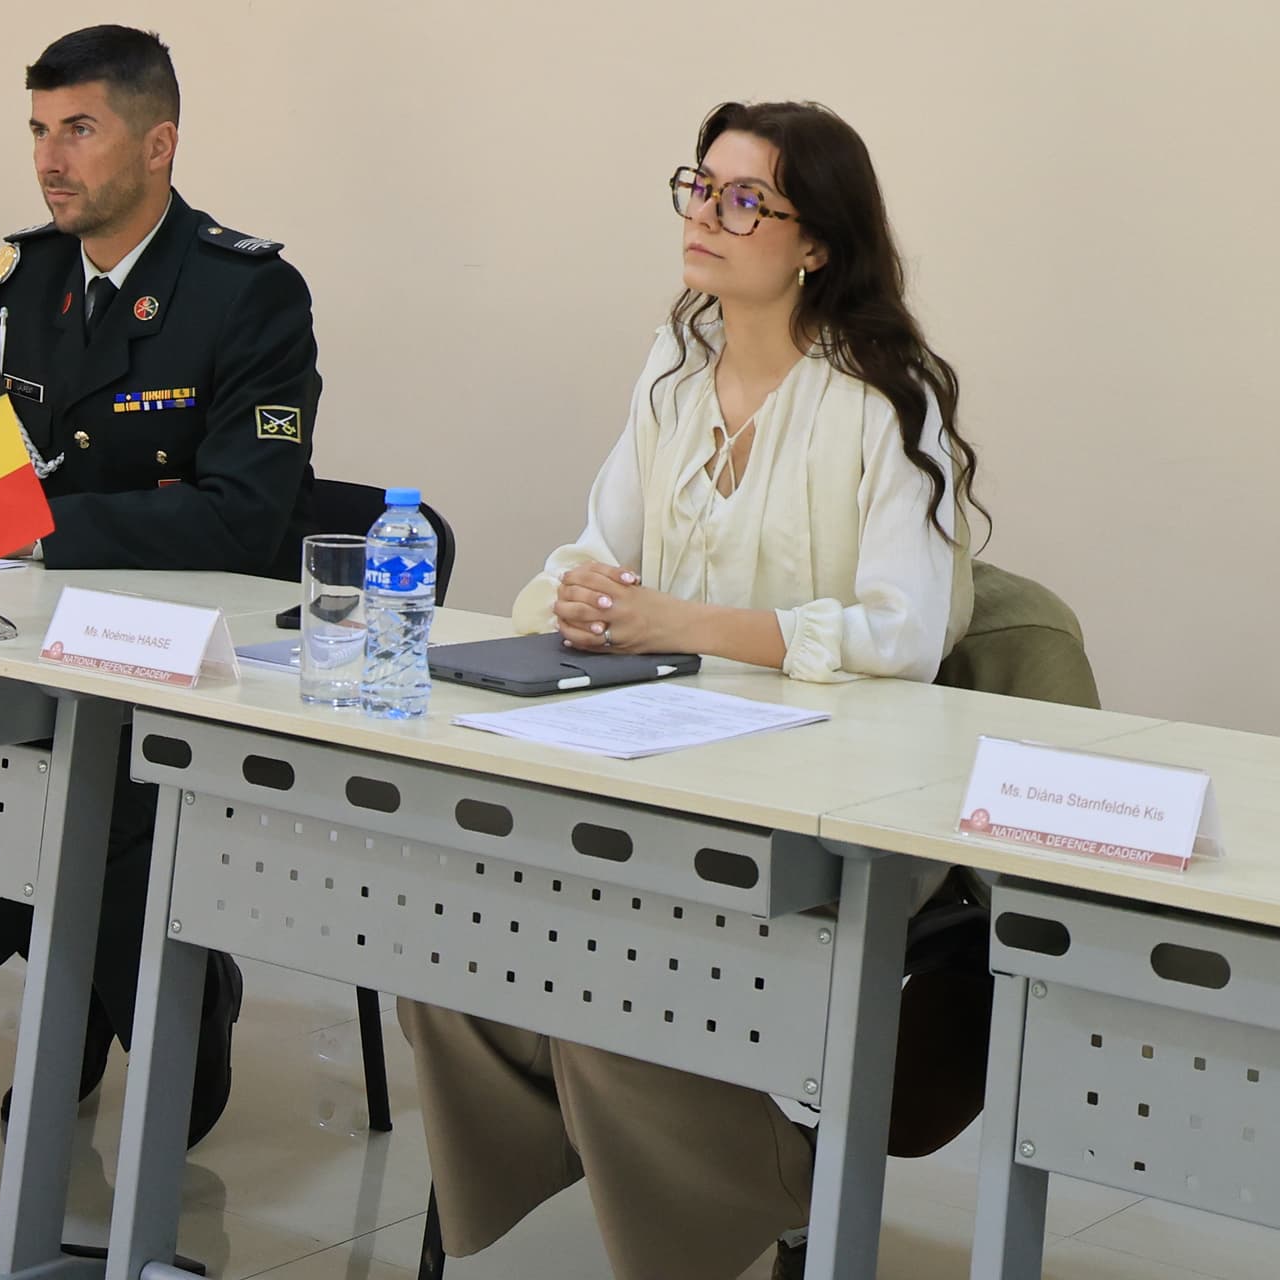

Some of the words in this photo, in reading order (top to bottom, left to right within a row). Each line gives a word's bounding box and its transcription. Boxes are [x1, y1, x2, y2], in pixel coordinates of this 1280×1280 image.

[136, 634, 173, 650] HAASE
[63, 653, 99, 669] NATIONAL
[99, 660, 135, 675] DEFENCE
[135, 666, 173, 681] ACADEMY
[1000, 781, 1023, 797] Ms.
[1026, 785, 1063, 805] Diána
[1143, 804, 1165, 822] Kis
[991, 825, 1043, 844] NATIONAL
[1045, 834, 1097, 854] DEFENCE
[1096, 842, 1155, 863] ACADEMY
